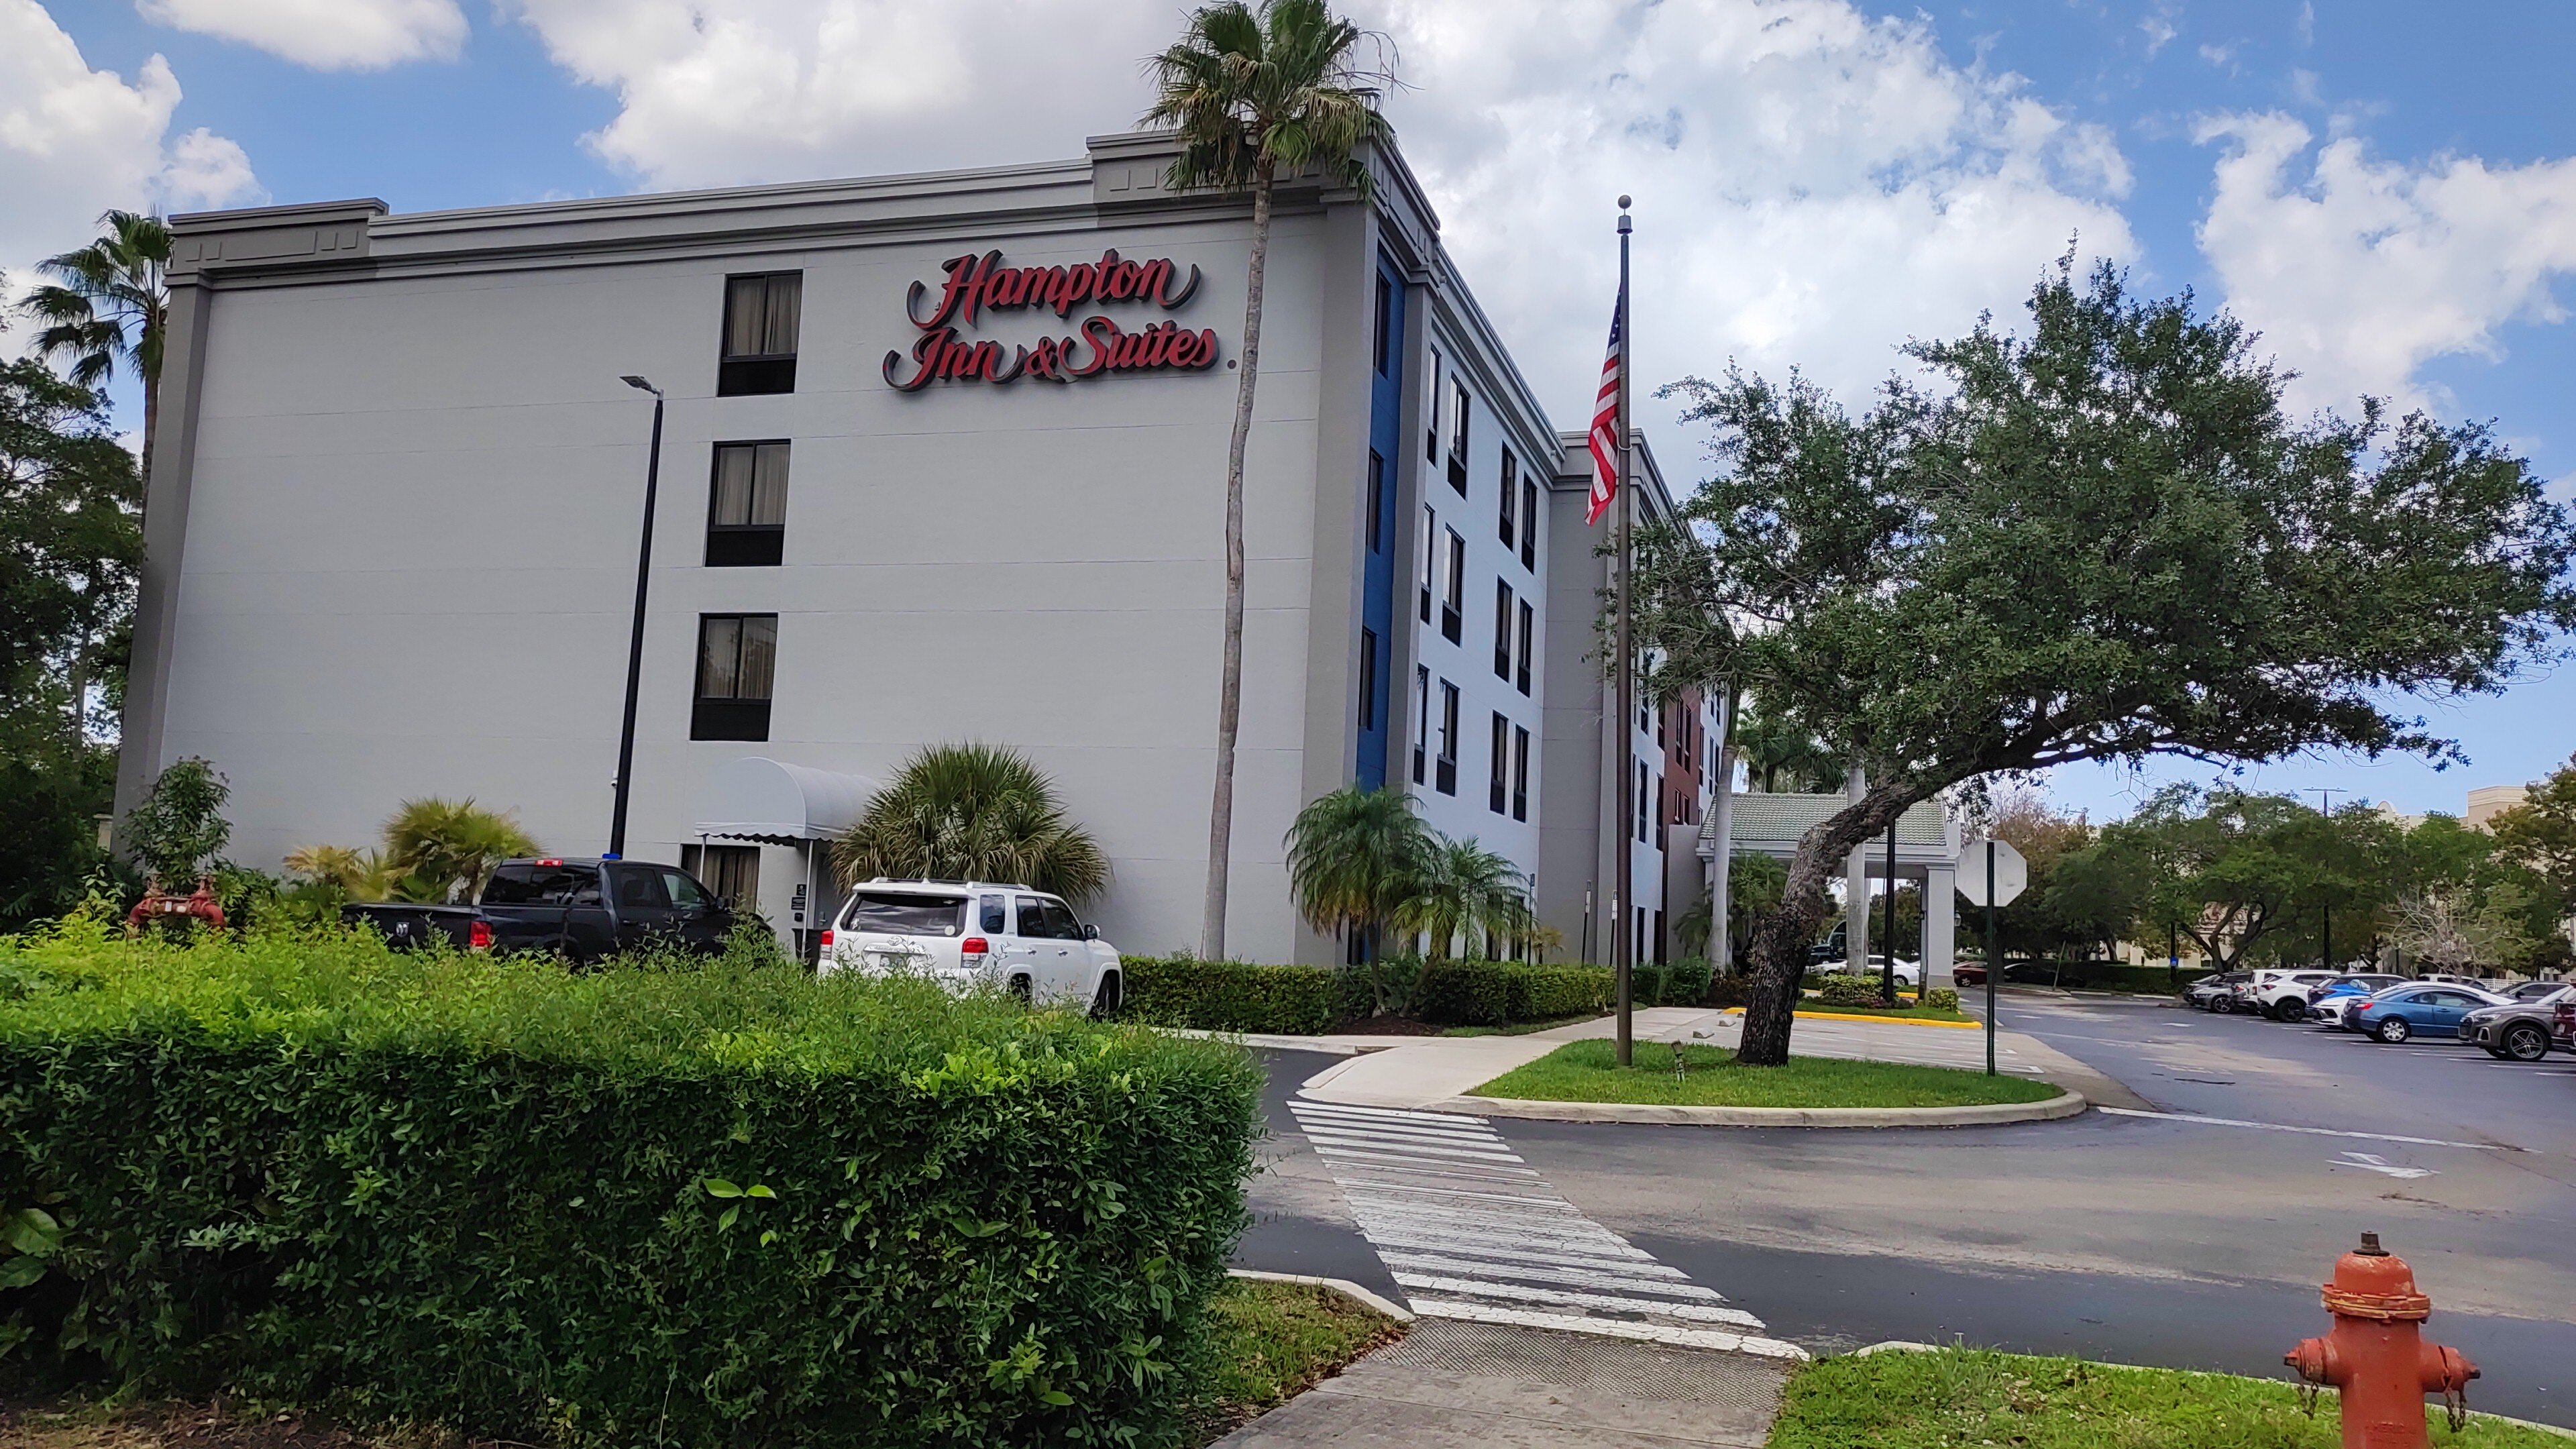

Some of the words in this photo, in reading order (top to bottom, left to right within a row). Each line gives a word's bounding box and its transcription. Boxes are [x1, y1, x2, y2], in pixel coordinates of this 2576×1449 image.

[906, 249, 1201, 331] Hampton
[883, 327, 1028, 392] Inn
[1024, 336, 1066, 383] &
[1059, 316, 1220, 376] Suites
